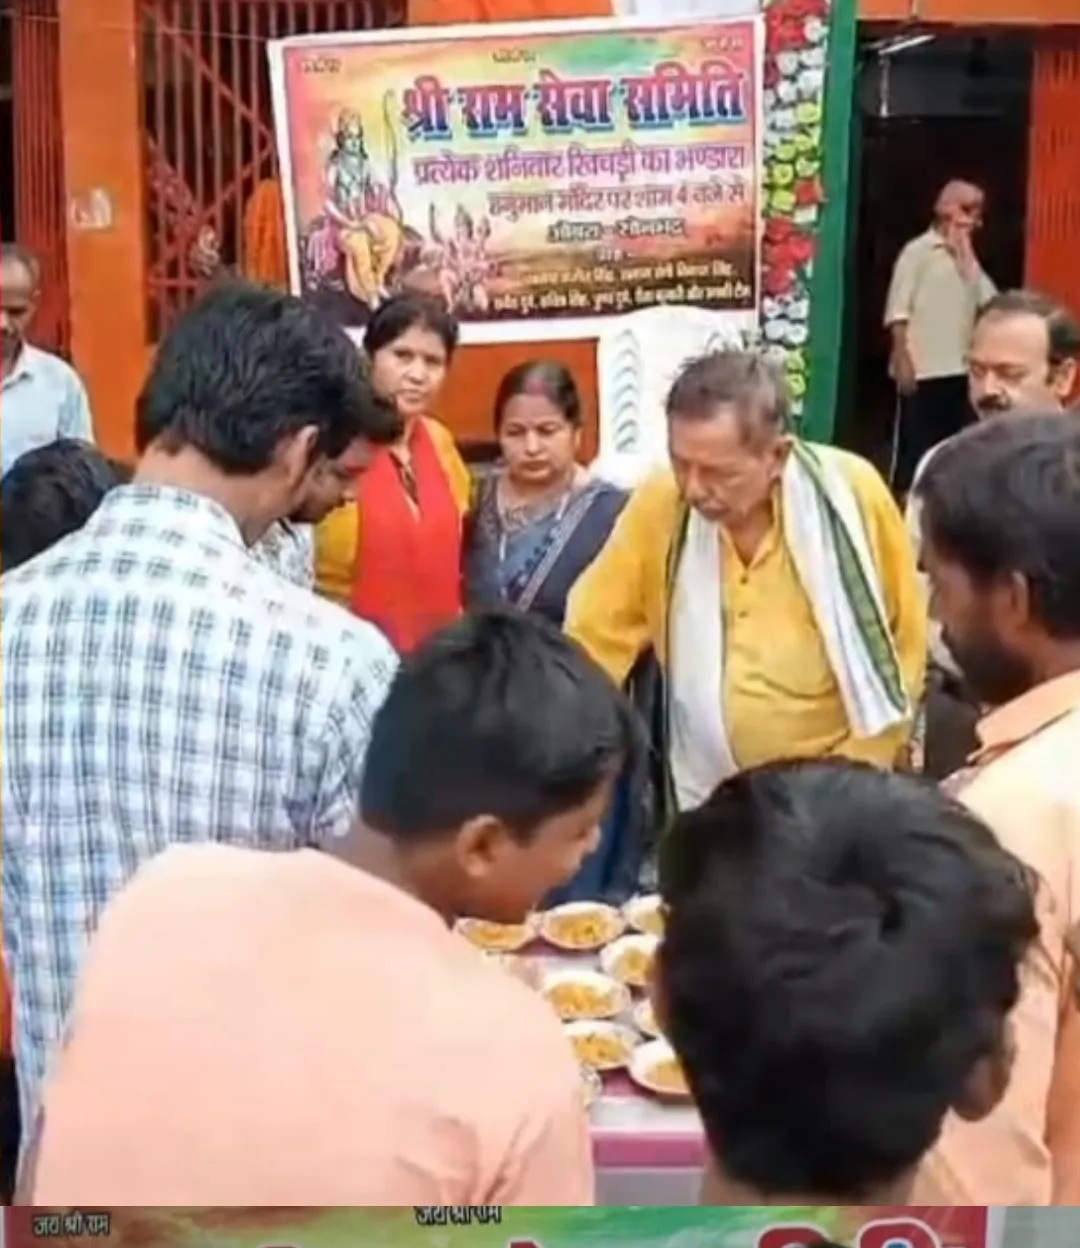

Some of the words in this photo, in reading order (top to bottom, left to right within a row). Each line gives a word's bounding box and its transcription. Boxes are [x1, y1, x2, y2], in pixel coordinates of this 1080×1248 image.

[401, 75, 452, 143] श्री
[460, 85, 528, 138] राम
[536, 69, 614, 135] सेवा
[622, 60, 749, 128] समिति
[413, 151, 478, 186] प्रत्येक
[484, 146, 565, 183] शनिवार
[568, 141, 636, 183] खिचड़ी
[641, 149, 669, 175] का
[674, 145, 744, 170] भण्डारा
[34, 1214, 61, 1237] जय
[64, 1210, 86, 1236] श्री
[87, 1213, 110, 1236] राम
